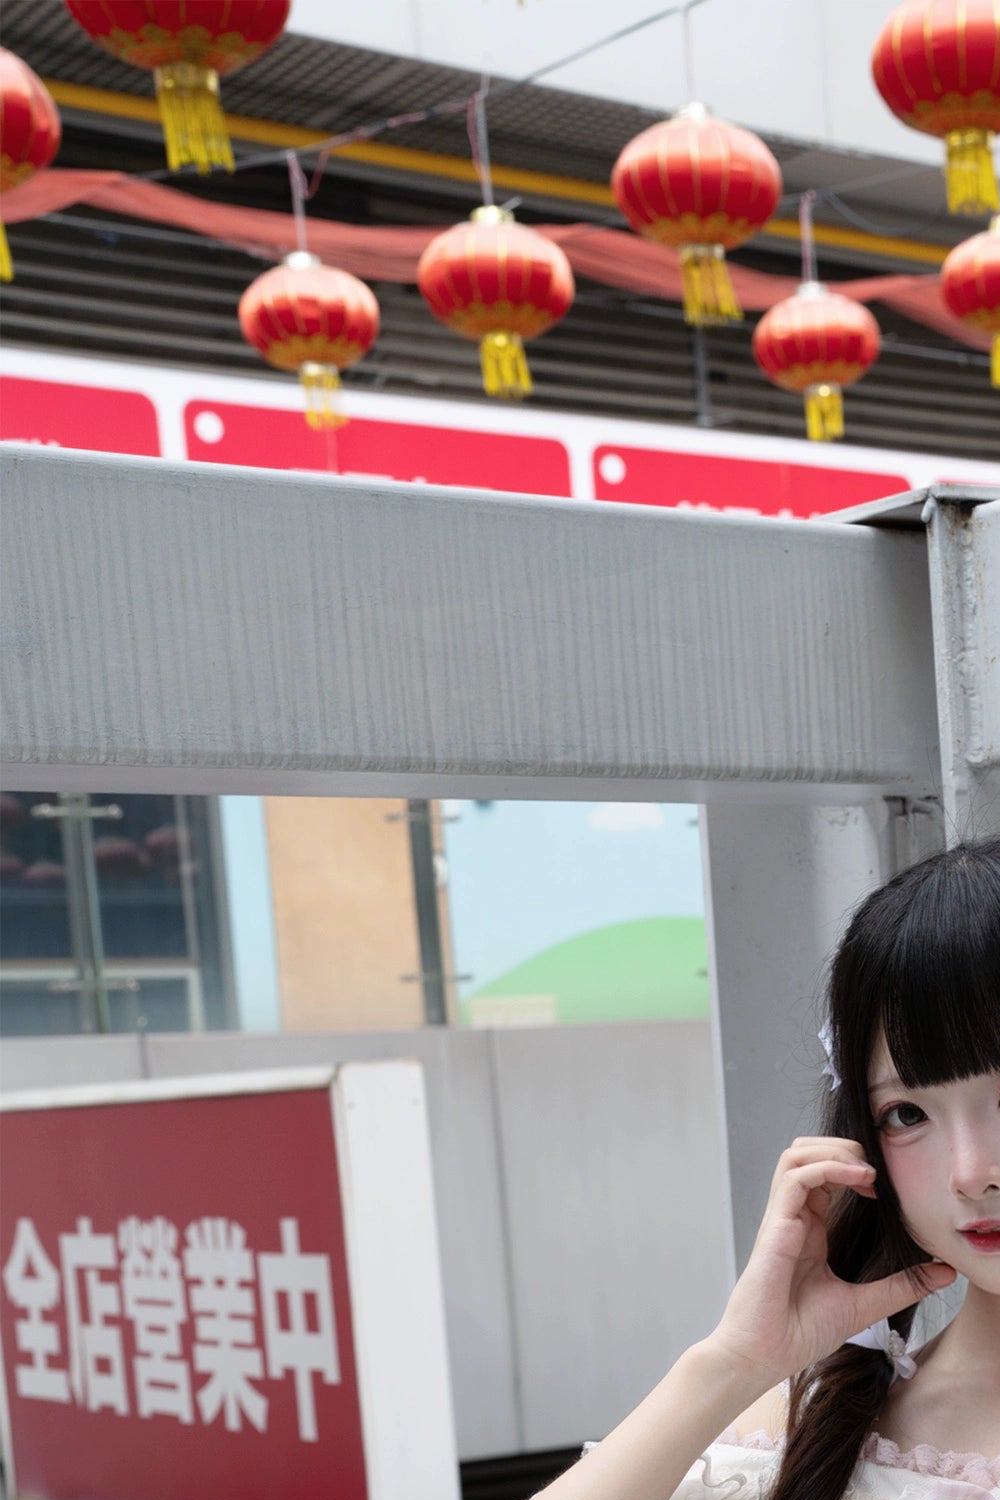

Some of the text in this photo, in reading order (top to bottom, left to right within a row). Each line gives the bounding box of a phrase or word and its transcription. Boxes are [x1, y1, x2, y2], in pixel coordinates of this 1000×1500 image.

[3, 1217, 340, 1442] 全店營業中
